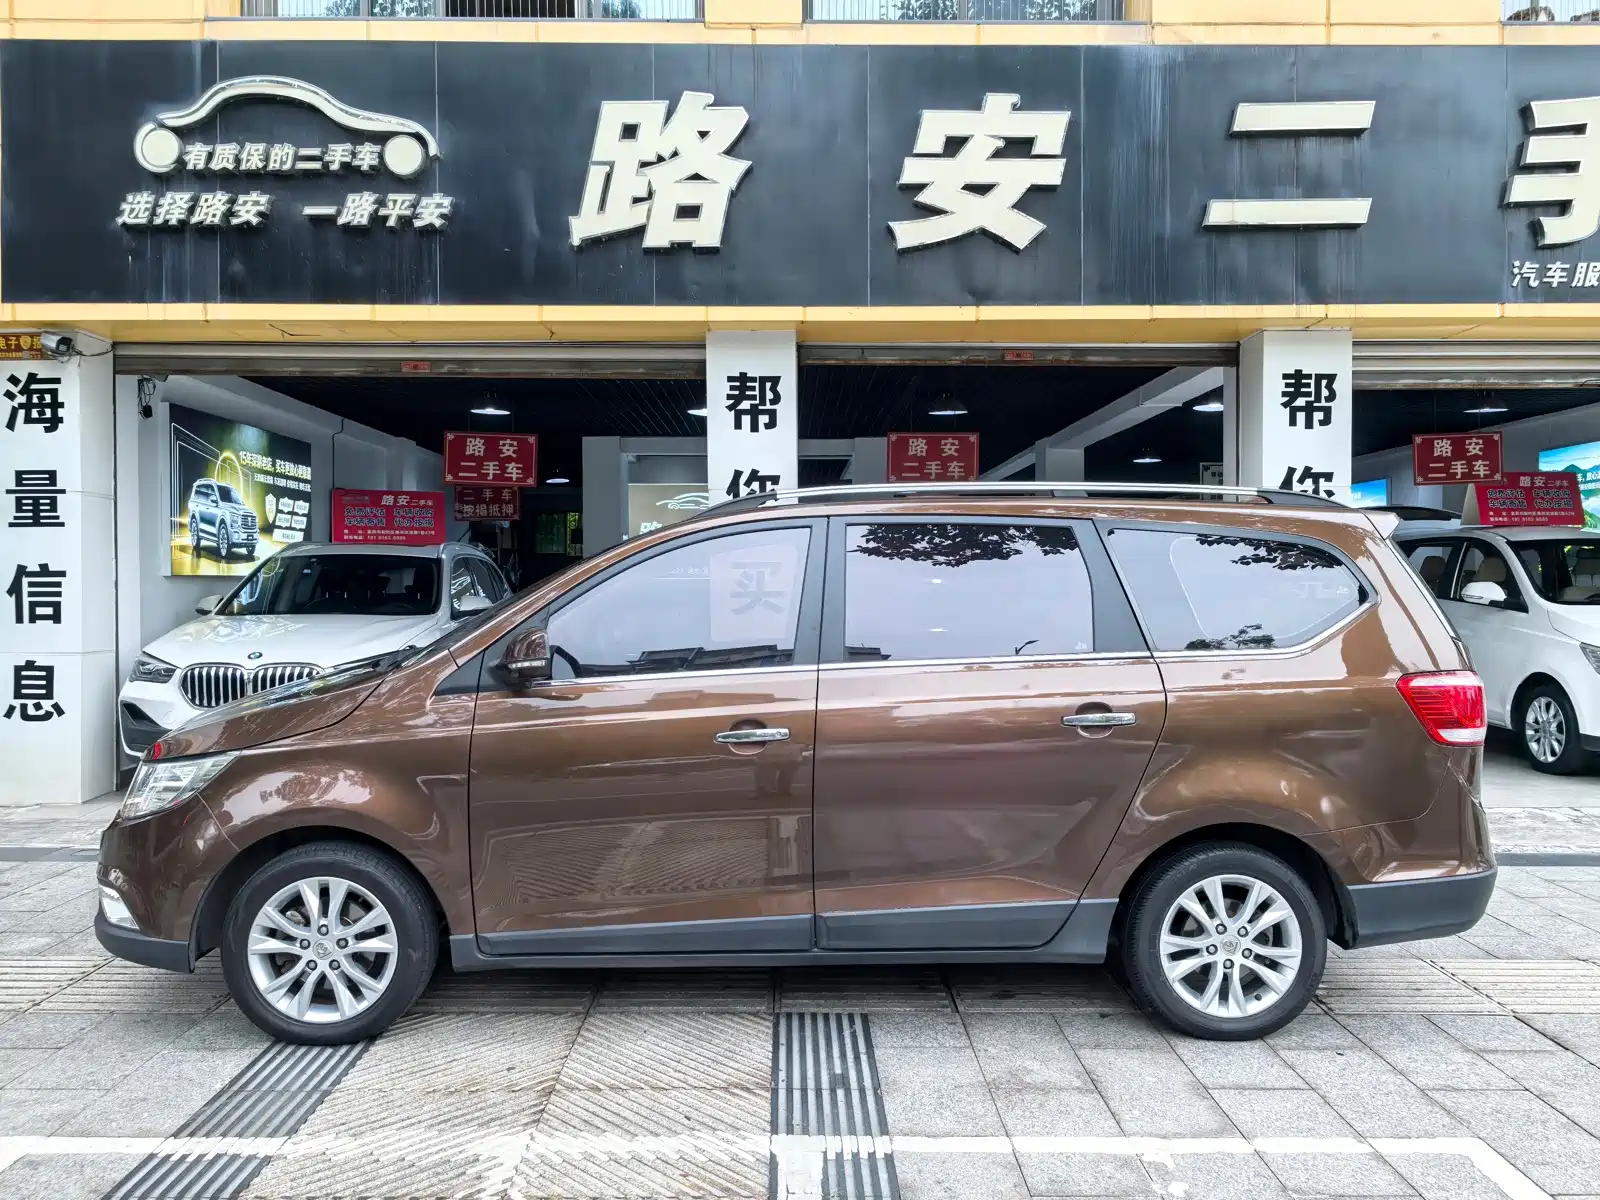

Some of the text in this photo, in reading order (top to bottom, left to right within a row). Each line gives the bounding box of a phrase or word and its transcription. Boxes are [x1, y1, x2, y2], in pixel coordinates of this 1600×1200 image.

[183, 142, 381, 171] 有质保的二手车
[116, 191, 455, 229] 选择路安 一路平安
[1511, 260, 1600, 288] 汽车服
[465, 437, 519, 458] 路安
[908, 438, 959, 456] 路安
[1433, 437, 1484, 457] 路安
[459, 461, 523, 481] 二手车
[902, 461, 965, 480] 二手车
[1428, 460, 1490, 479] 二手车
[463, 489, 513, 501] 二手车
[463, 504, 514, 517] 按揭抵押
[3, 372, 66, 722] 海量信息
